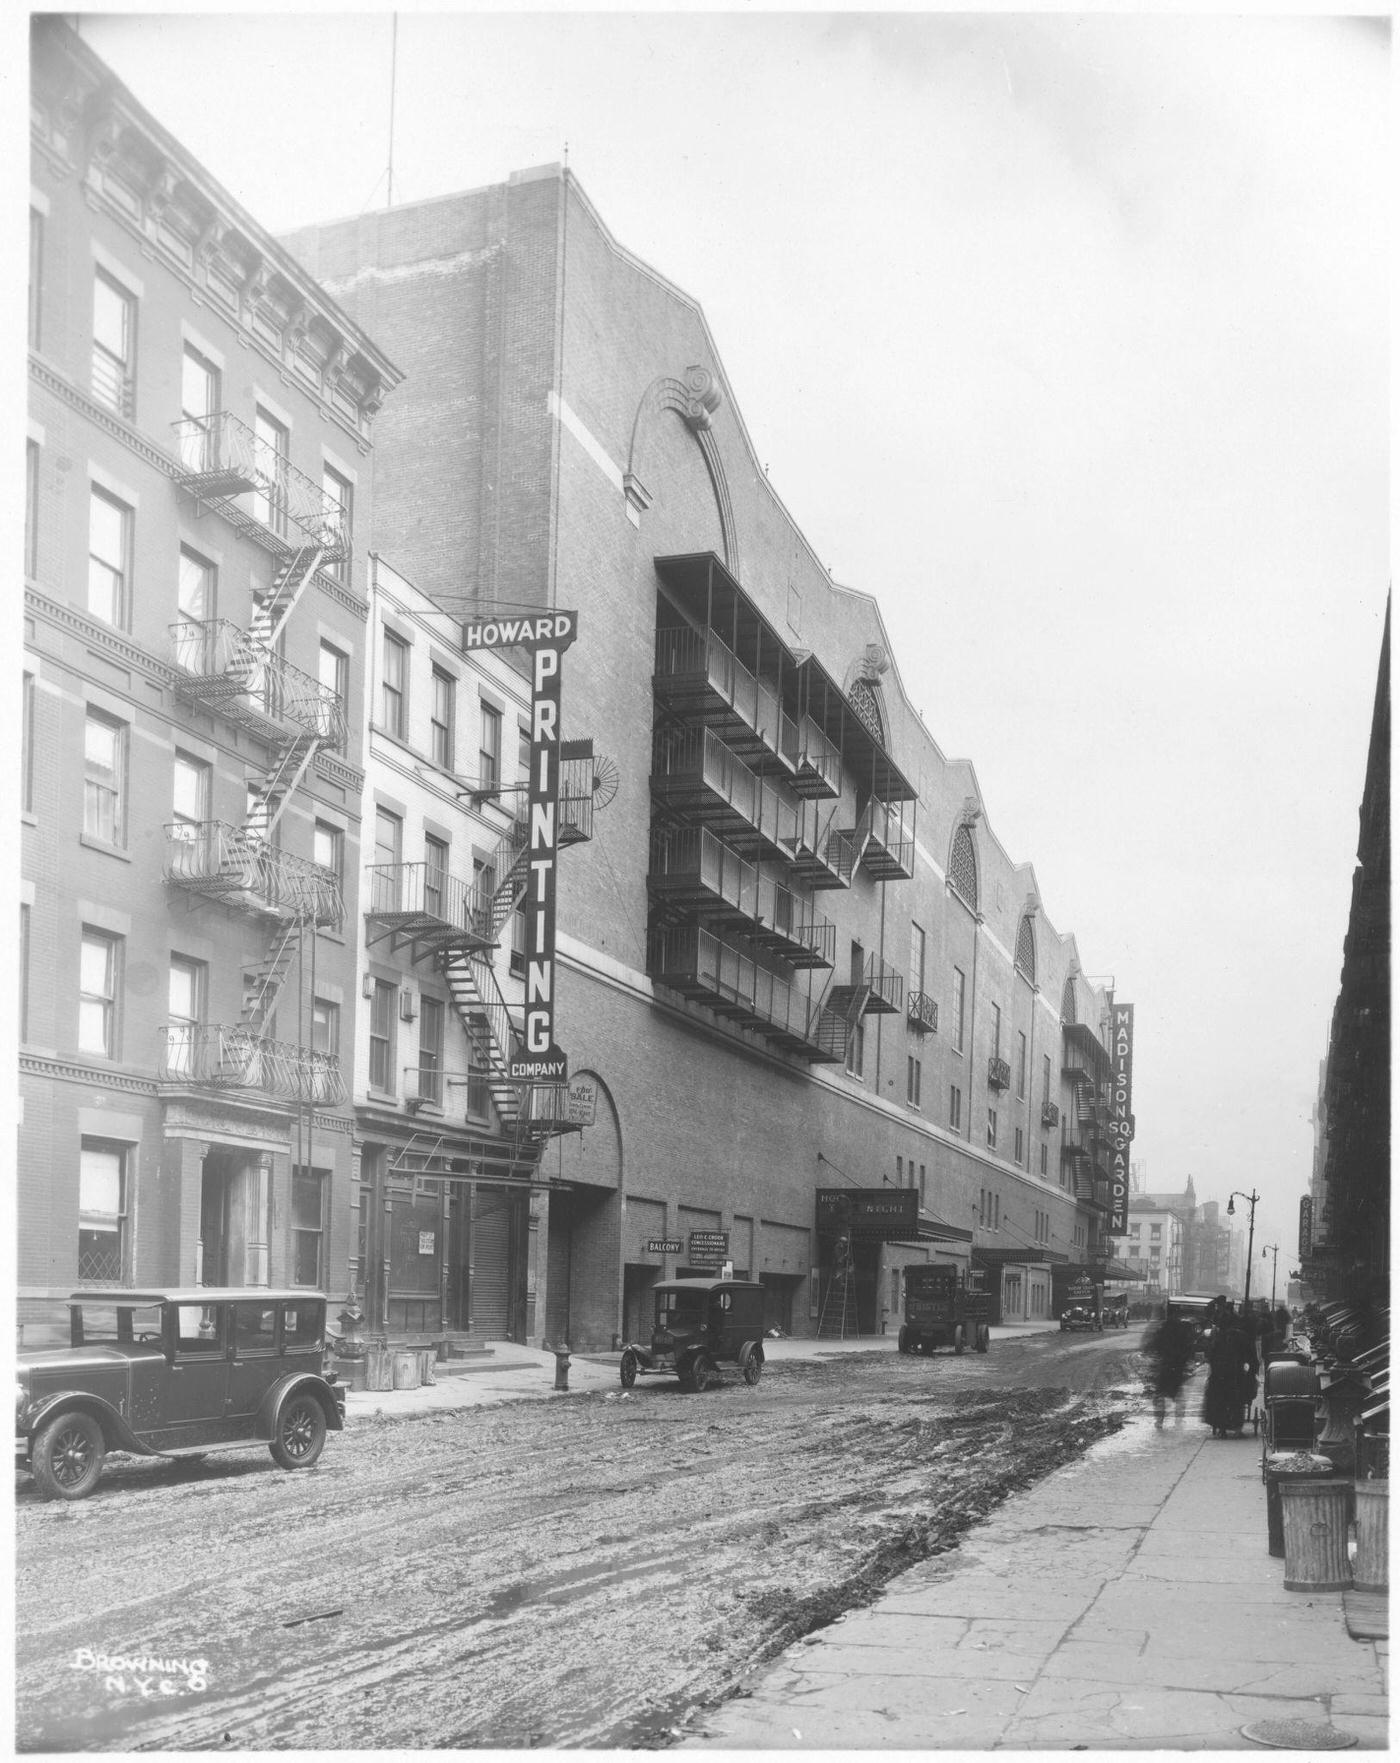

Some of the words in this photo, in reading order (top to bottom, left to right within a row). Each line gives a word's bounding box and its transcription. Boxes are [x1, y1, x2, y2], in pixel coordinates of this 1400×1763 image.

[467, 616, 571, 647] HOWARD
[528, 649, 558, 1053] PRINTING
[512, 1062, 565, 1077] COMPANY
[1116, 1011, 1129, 1118] MADISON
[1112, 1138, 1127, 1228] GARDEN
[649, 1242, 680, 1251] BALCONY
